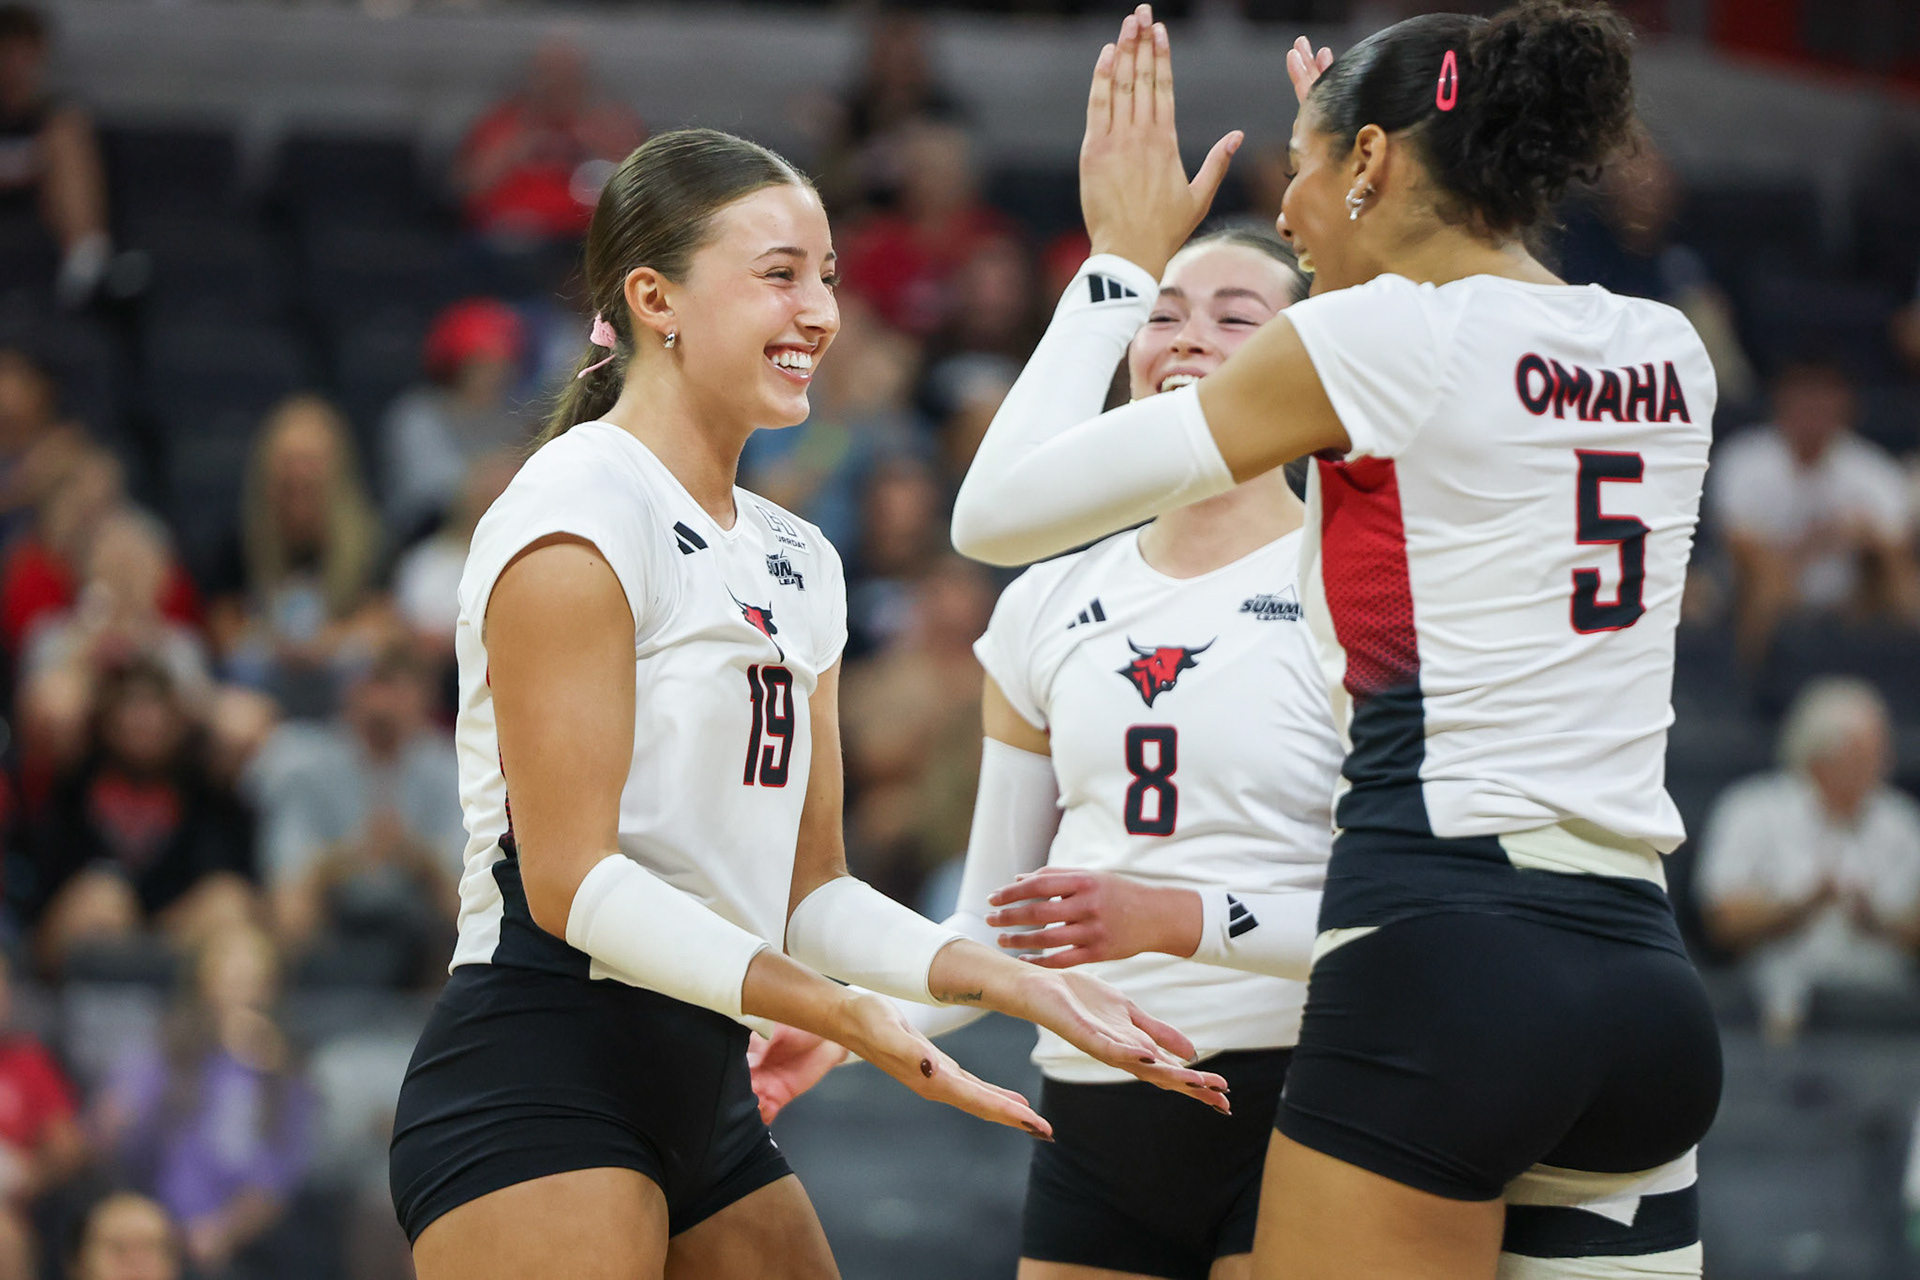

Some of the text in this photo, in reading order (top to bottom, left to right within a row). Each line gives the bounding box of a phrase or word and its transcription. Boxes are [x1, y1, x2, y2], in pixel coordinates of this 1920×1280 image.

[1514, 352, 1692, 424] OMAHA
[776, 535, 806, 549] URRDAT
[1570, 448, 1652, 635] 5
[1239, 599, 1303, 618] SUMM
[743, 664, 794, 787] 19
[1124, 724, 1178, 837] 8
